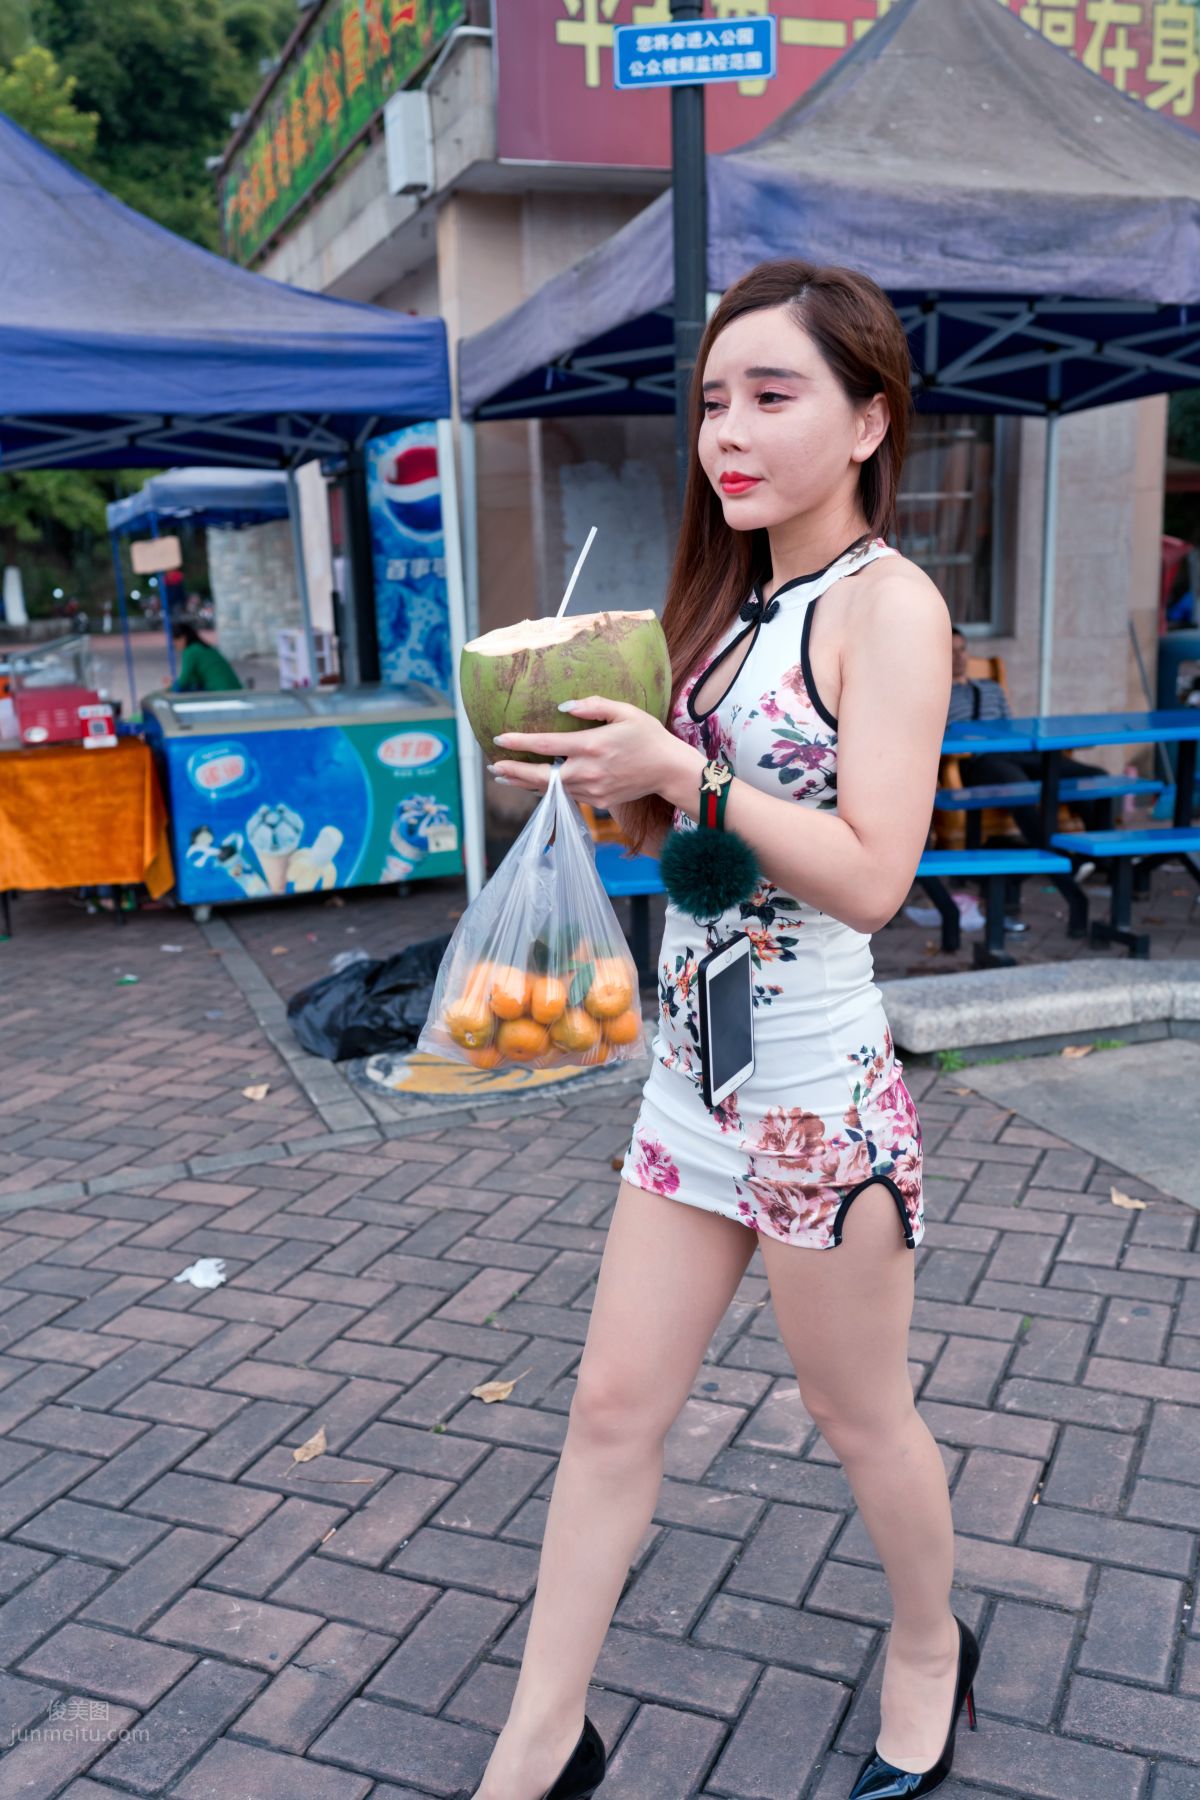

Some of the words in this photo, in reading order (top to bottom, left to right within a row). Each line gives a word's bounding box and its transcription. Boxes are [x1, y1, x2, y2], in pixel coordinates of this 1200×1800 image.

[629, 51, 763, 77] 公众视频监控范围
